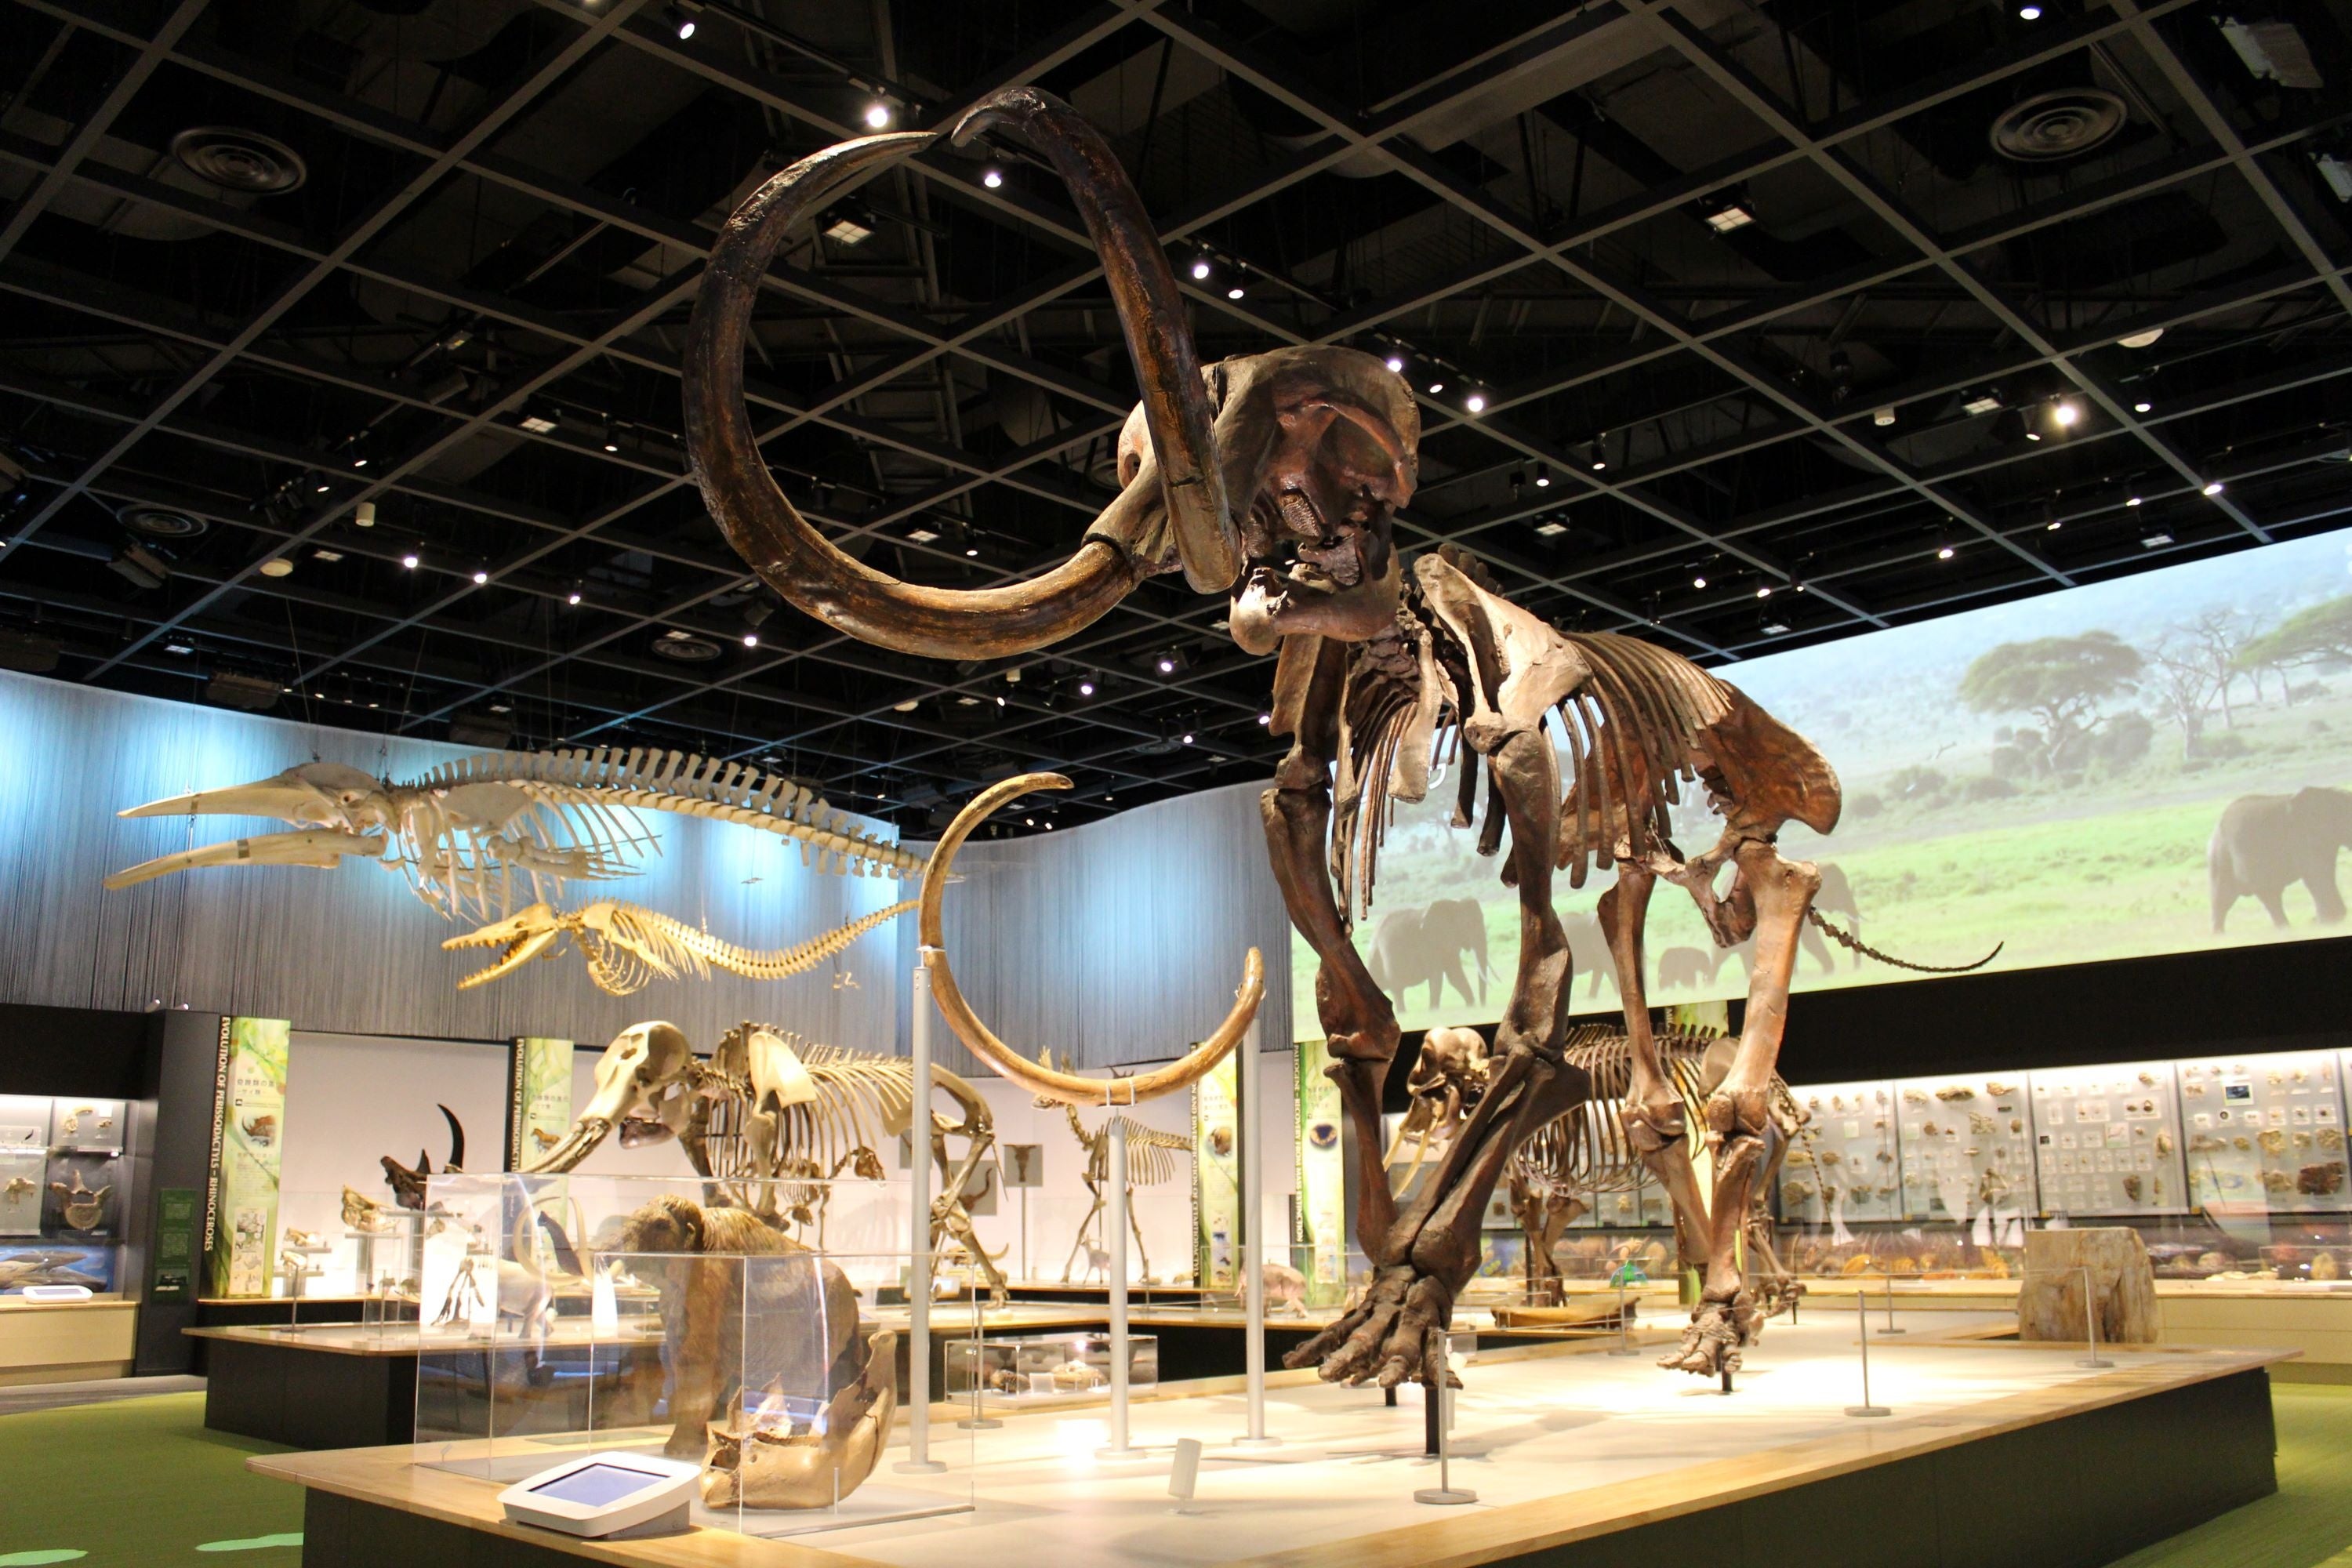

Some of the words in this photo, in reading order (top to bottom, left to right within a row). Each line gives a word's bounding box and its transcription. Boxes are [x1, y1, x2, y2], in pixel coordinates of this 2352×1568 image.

[218, 1016, 230, 1073] EVOLUTION
[515, 1038, 524, 1089] EVOLUTION
[216, 1075, 226, 1089] OF
[514, 1091, 522, 1103] OF
[211, 1090, 225, 1168] PERISSODACTYLS
[511, 1104, 522, 1172] PERISSODACTYL
[205, 1177, 218, 1251] RHINOCEROSES
[1192, 1188, 1198, 1199] OF
